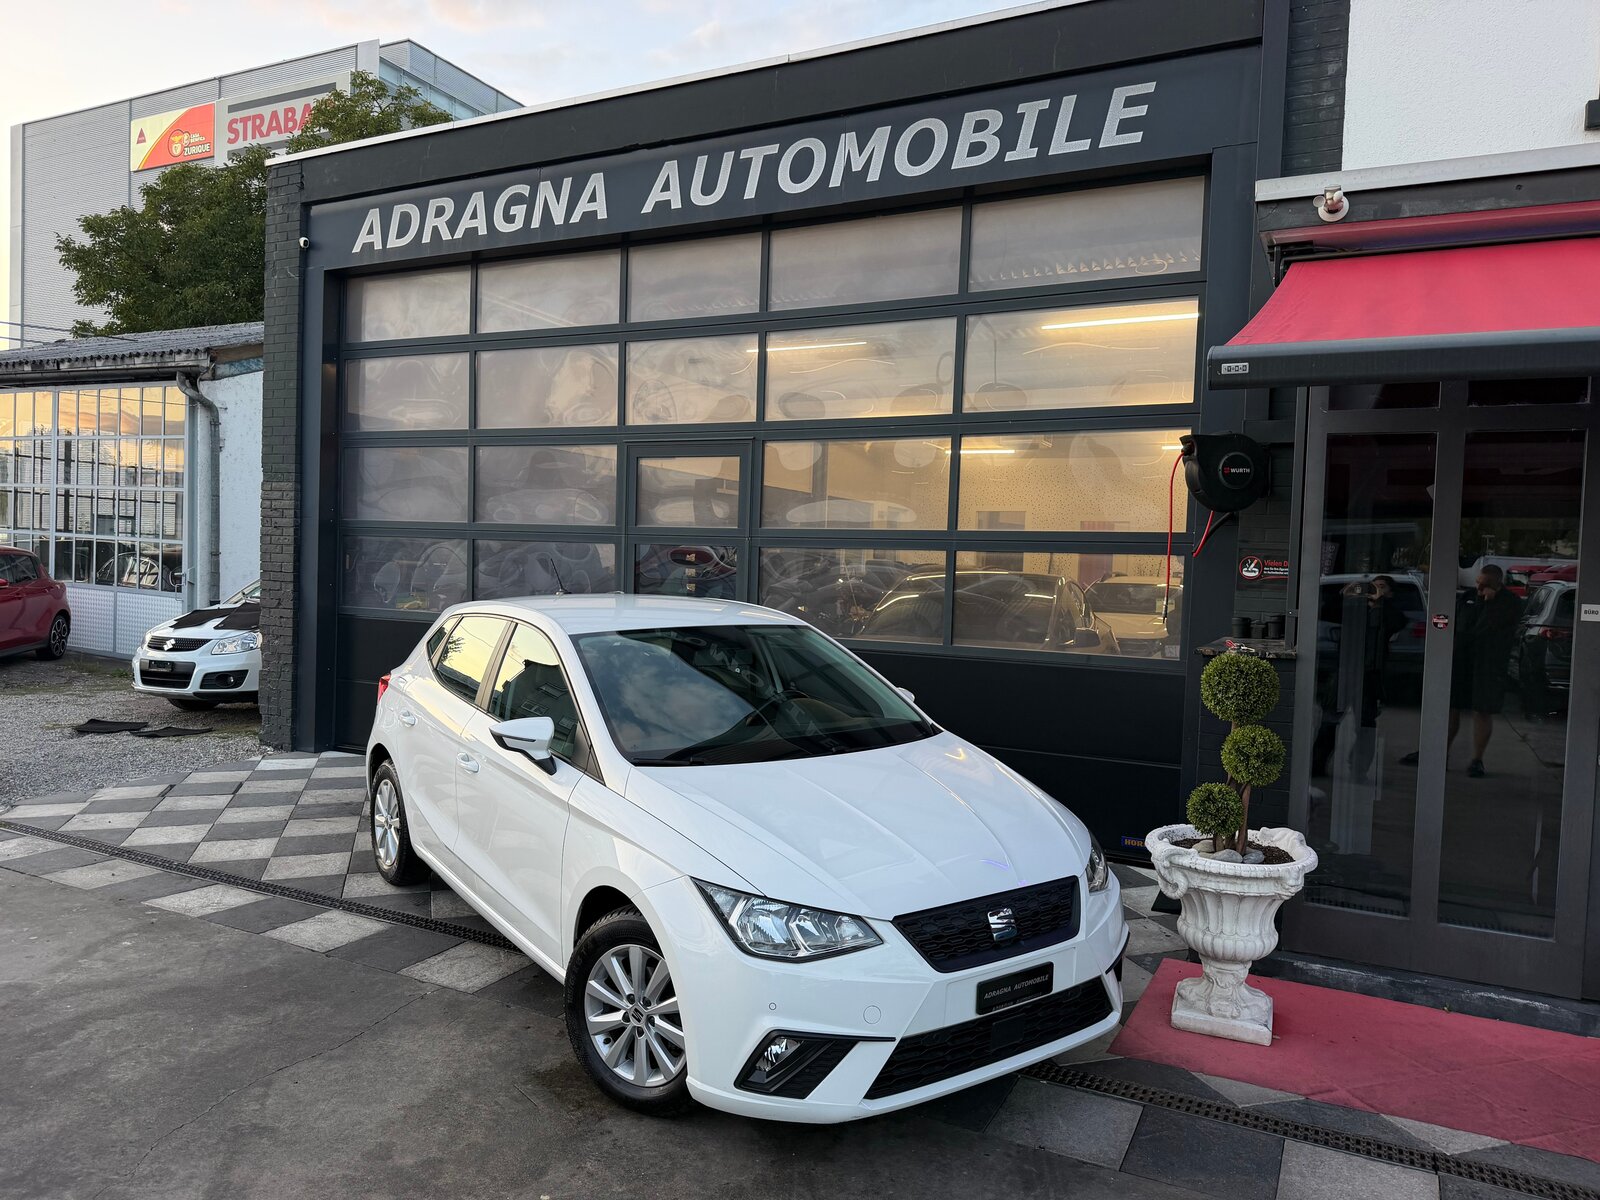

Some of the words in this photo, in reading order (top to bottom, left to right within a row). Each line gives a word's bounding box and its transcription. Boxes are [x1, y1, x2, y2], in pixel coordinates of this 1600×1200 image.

[227, 103, 316, 144] STRABA
[184, 143, 211, 156] ZURIQUE
[352, 172, 608, 253] ADRAGNA
[641, 81, 1157, 213] AUTOMOBILE
[1124, 839, 1145, 847] HOR
[984, 986, 1012, 1000] ADRAGNA
[1014, 974, 1049, 990] AUTOMOBILE
